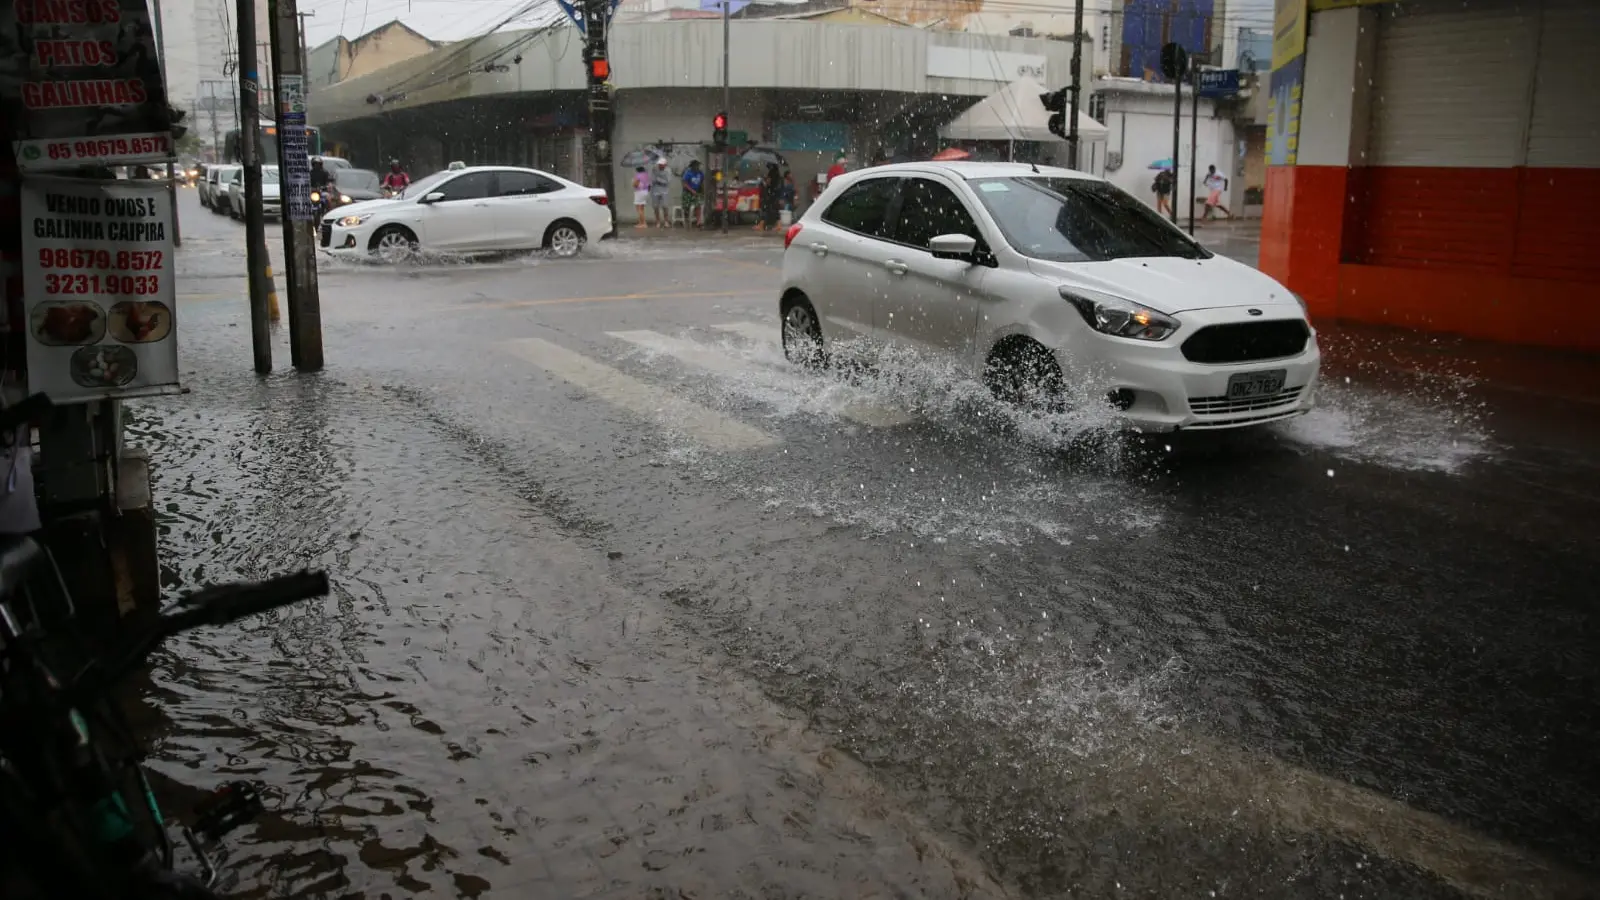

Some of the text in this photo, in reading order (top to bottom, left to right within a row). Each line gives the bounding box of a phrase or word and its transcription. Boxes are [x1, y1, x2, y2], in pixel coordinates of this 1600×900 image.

[35, 40, 118, 66] PATOS
[21, 79, 147, 109] GALINHAS
[47, 136, 169, 160] 85 98679.8572
[46, 194, 156, 218] VENDO OVOS E
[34, 218, 165, 241] GALINHA CAIPIRA
[39, 248, 164, 270] 98679.8572
[45, 273, 159, 295] 3231.9033
